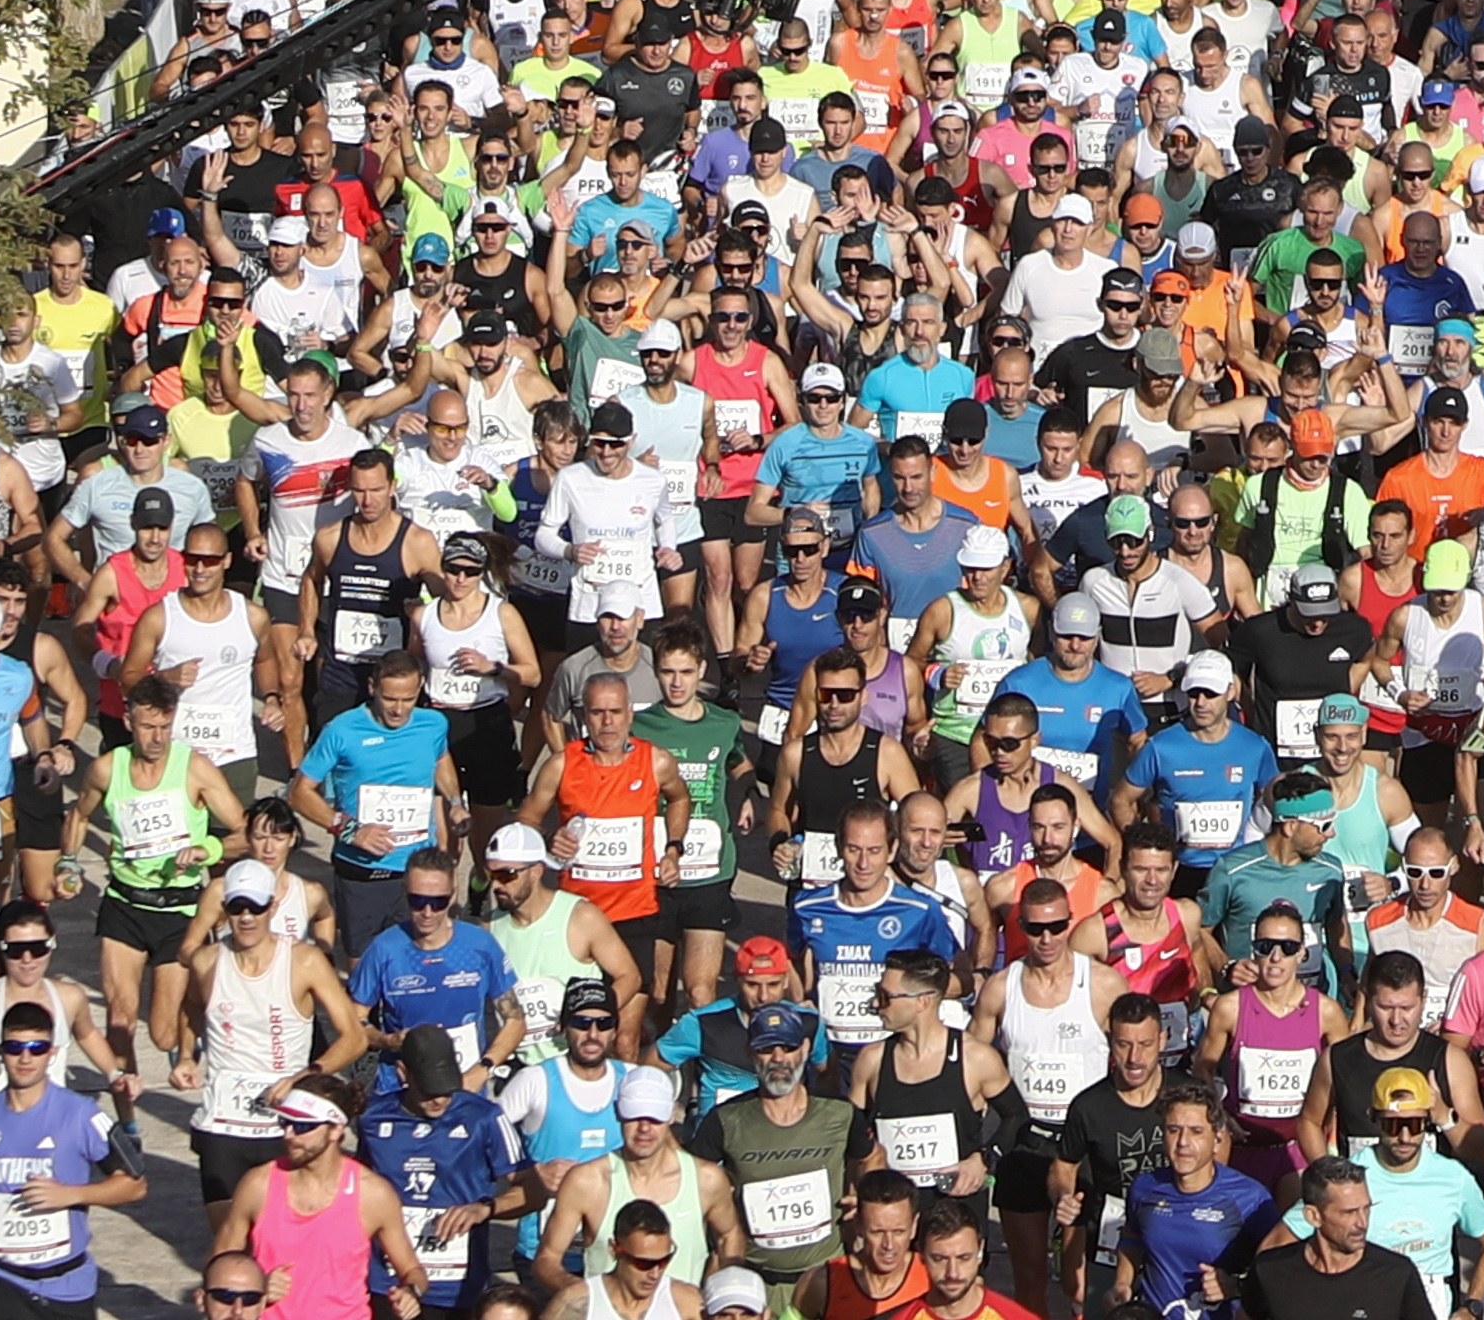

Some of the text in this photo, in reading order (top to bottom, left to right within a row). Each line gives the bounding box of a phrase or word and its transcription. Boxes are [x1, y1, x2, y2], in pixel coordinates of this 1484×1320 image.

[975, 77, 1002, 87] 1911
[578, 179, 605, 192] PFR
[588, 527, 636, 538] eurolife
[524, 563, 559, 582] 1319
[596, 563, 633, 576] 2186
[351, 633, 388, 647] 1767
[443, 681, 480, 695] 2140
[183, 727, 221, 739] 1984
[375, 808, 416, 822] 3317
[131, 814, 172, 834] 1253
[1189, 818, 1229, 832] 1990
[587, 841, 627, 857] 2269
[685, 842, 705, 856] 87
[525, 1001, 547, 1017] 89
[835, 1002, 869, 1016] 226
[1023, 1078, 1066, 1093] 1449
[1256, 1075, 1300, 1090] 1628
[741, 1146, 833, 1163] DYNAFIT
[894, 1142, 938, 1160] 2517
[767, 1200, 814, 1222] 1796
[3, 1218, 51, 1237] 2093
